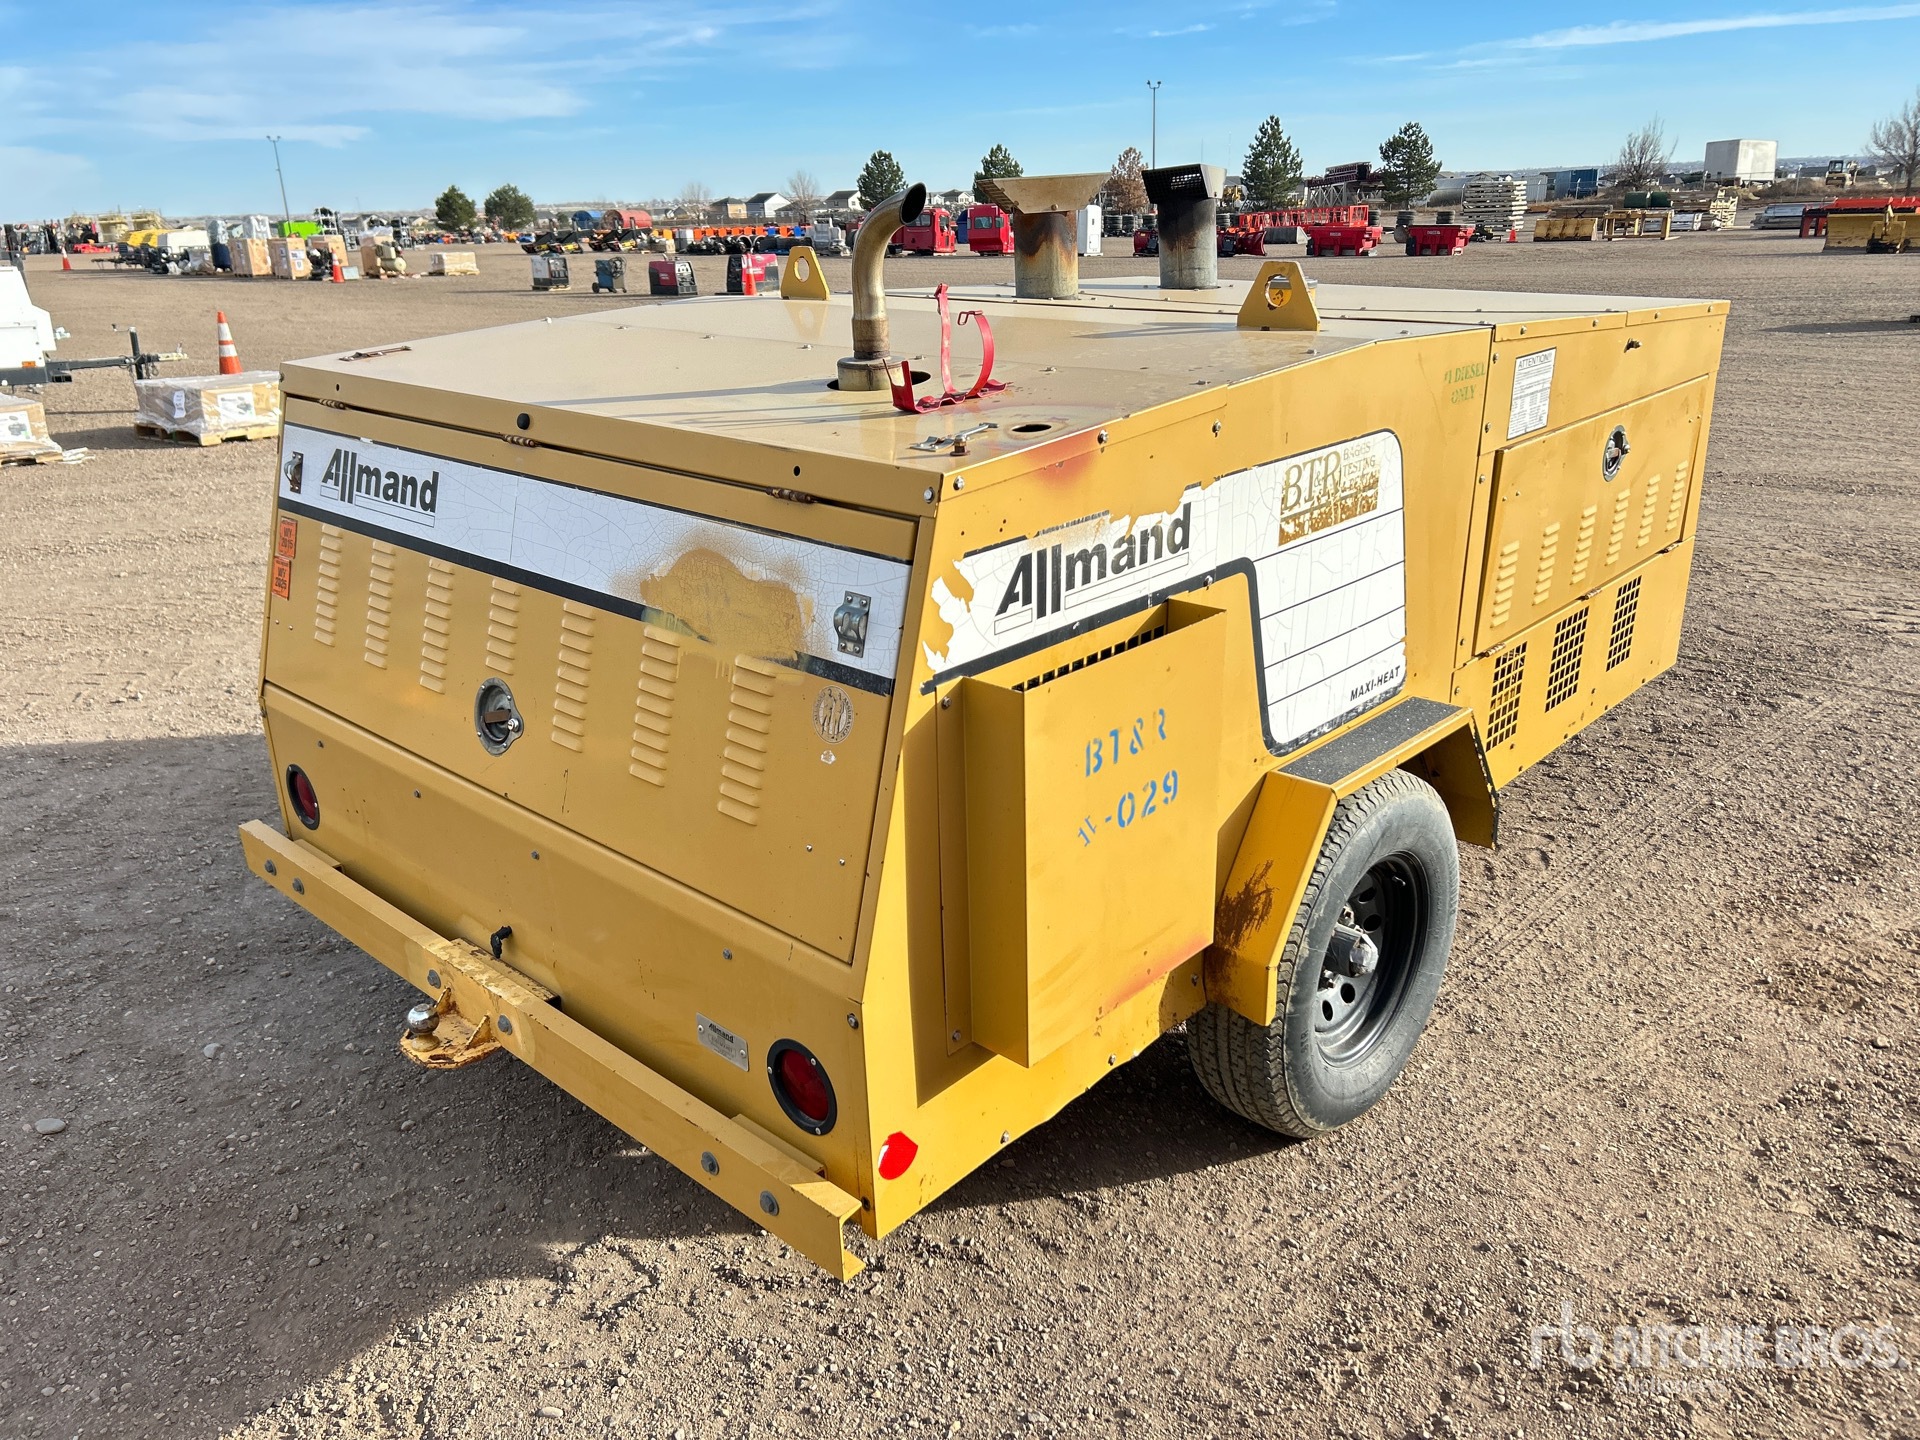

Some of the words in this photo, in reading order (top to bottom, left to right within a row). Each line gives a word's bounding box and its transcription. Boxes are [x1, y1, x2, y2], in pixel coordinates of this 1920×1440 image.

[1454, 362, 1485, 383] DIESEL
[1451, 384, 1475, 404] ONLY
[321, 448, 440, 514] Allmand
[994, 501, 1192, 621] Allmand
[1350, 665, 1401, 702] MAXI-HEAT
[708, 1022, 734, 1044] Allmand
